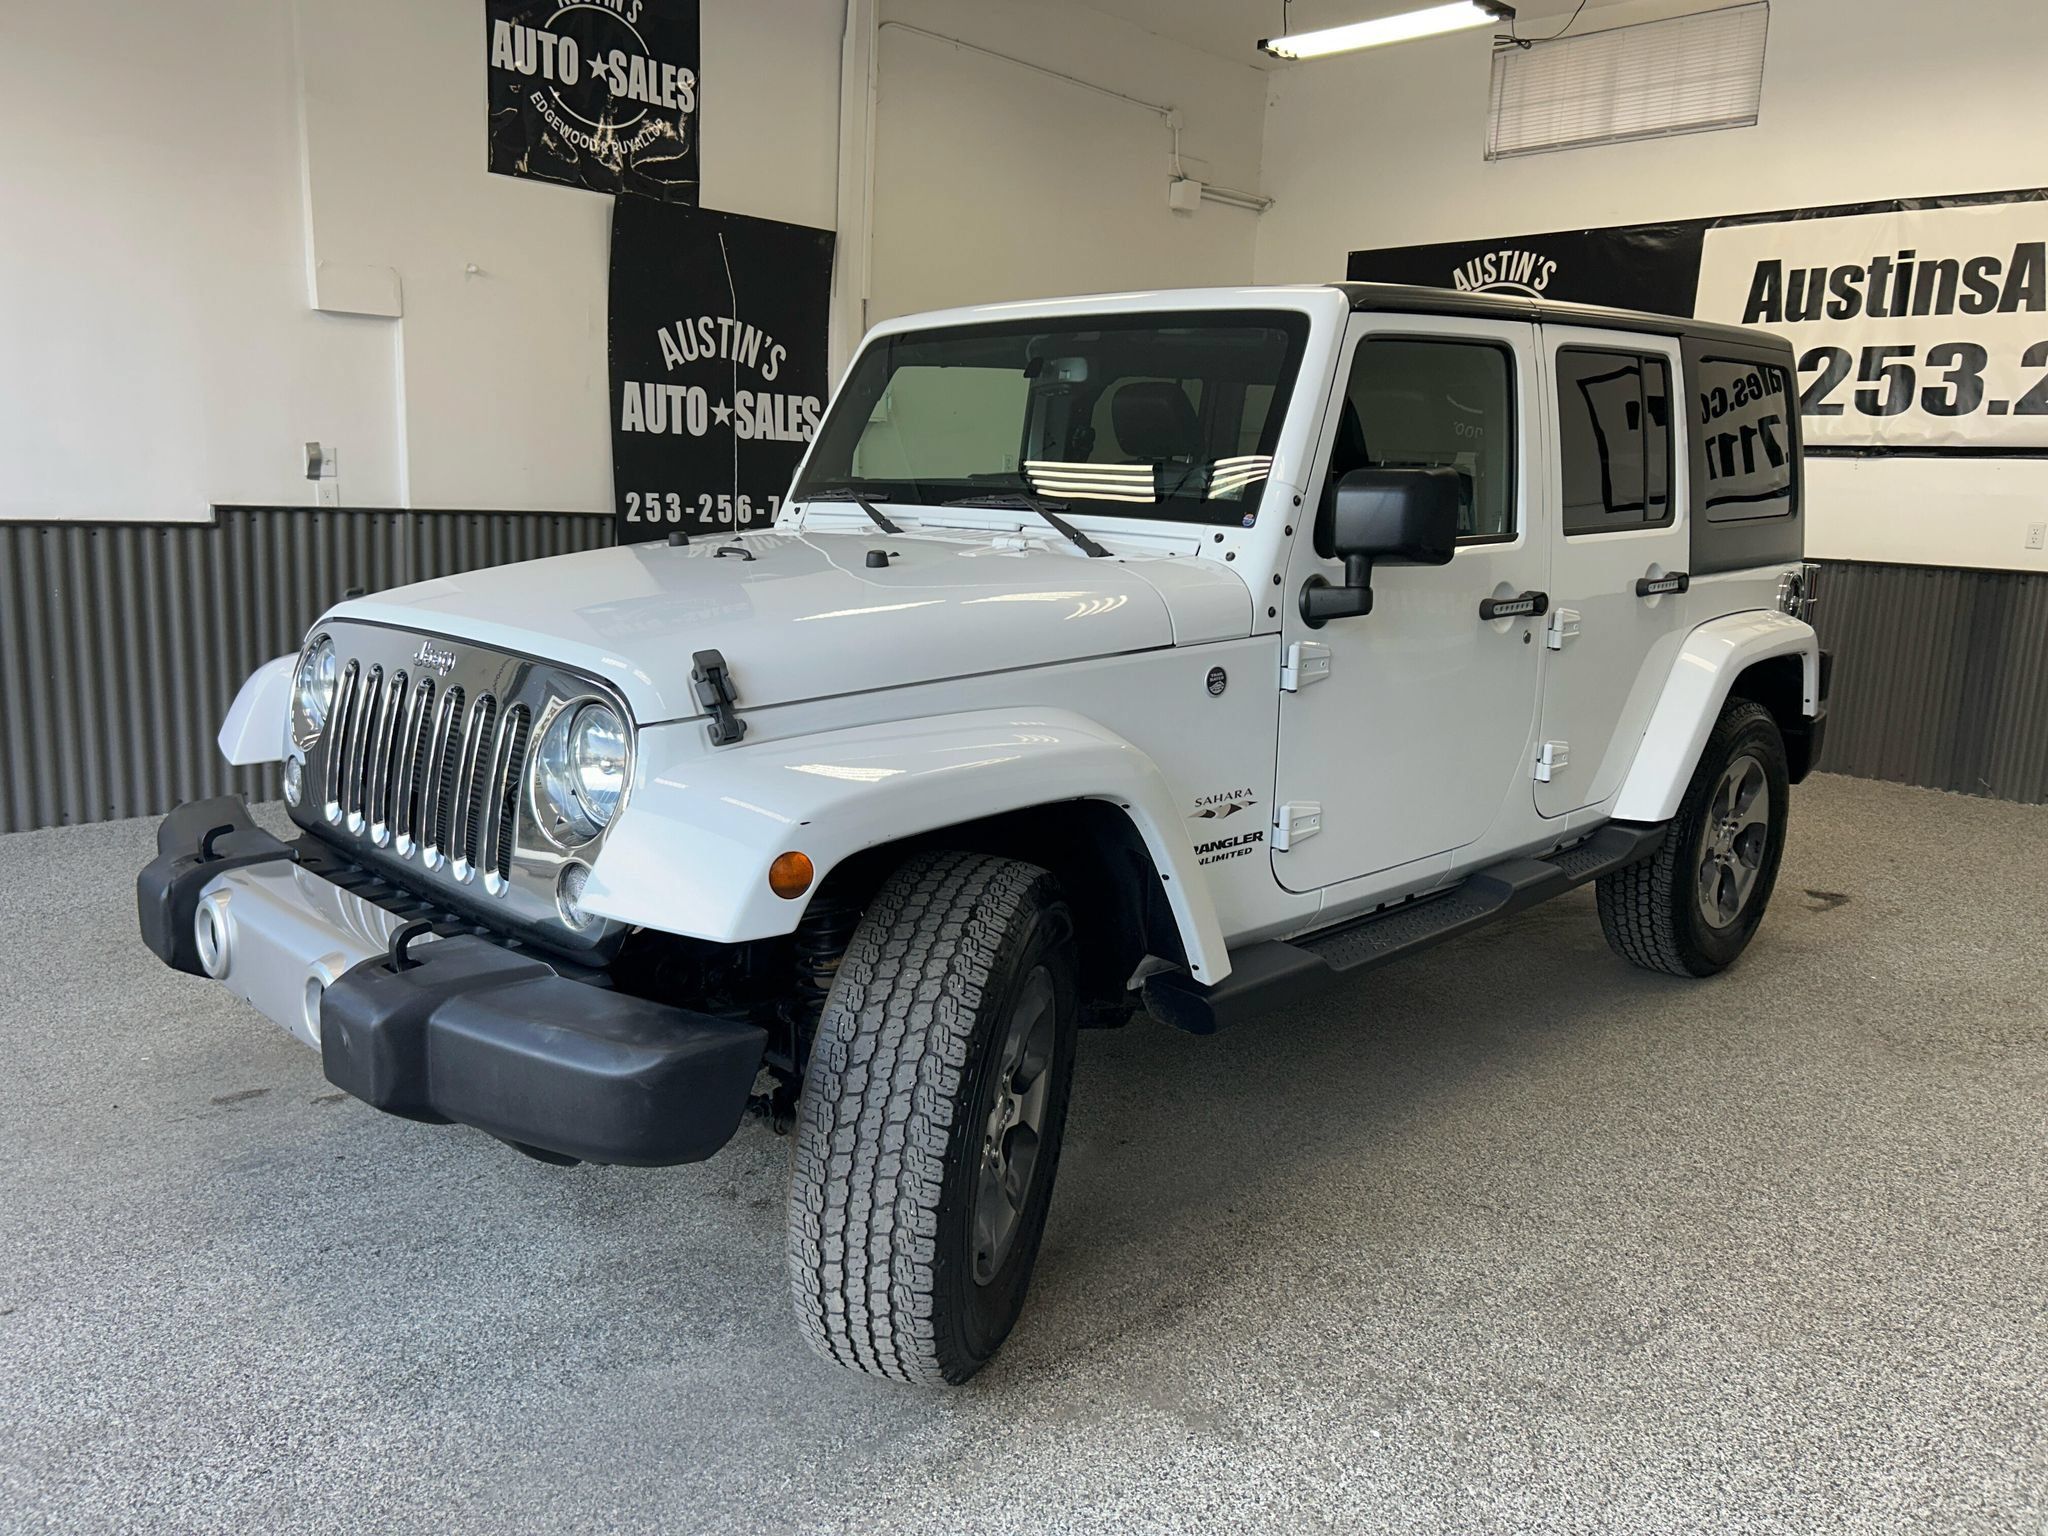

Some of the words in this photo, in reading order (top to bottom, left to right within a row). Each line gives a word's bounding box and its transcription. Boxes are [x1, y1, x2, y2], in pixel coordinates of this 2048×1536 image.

[491, 19, 579, 86] AUTO
[607, 49, 696, 114] SALES
[530, 91, 599, 152] EDGEWOOD
[1453, 250, 1557, 292] AUSTIN'S
[1742, 242, 2046, 324] AustinsA
[657, 316, 787, 382] AUSTIN'S
[1797, 341, 2048, 417] 253.2
[621, 381, 708, 437] AUTO
[735, 389, 821, 443] SALES
[625, 492, 780, 524] 253-256-7
[413, 641, 456, 677] Jeep
[1195, 788, 1253, 808] SAHARA
